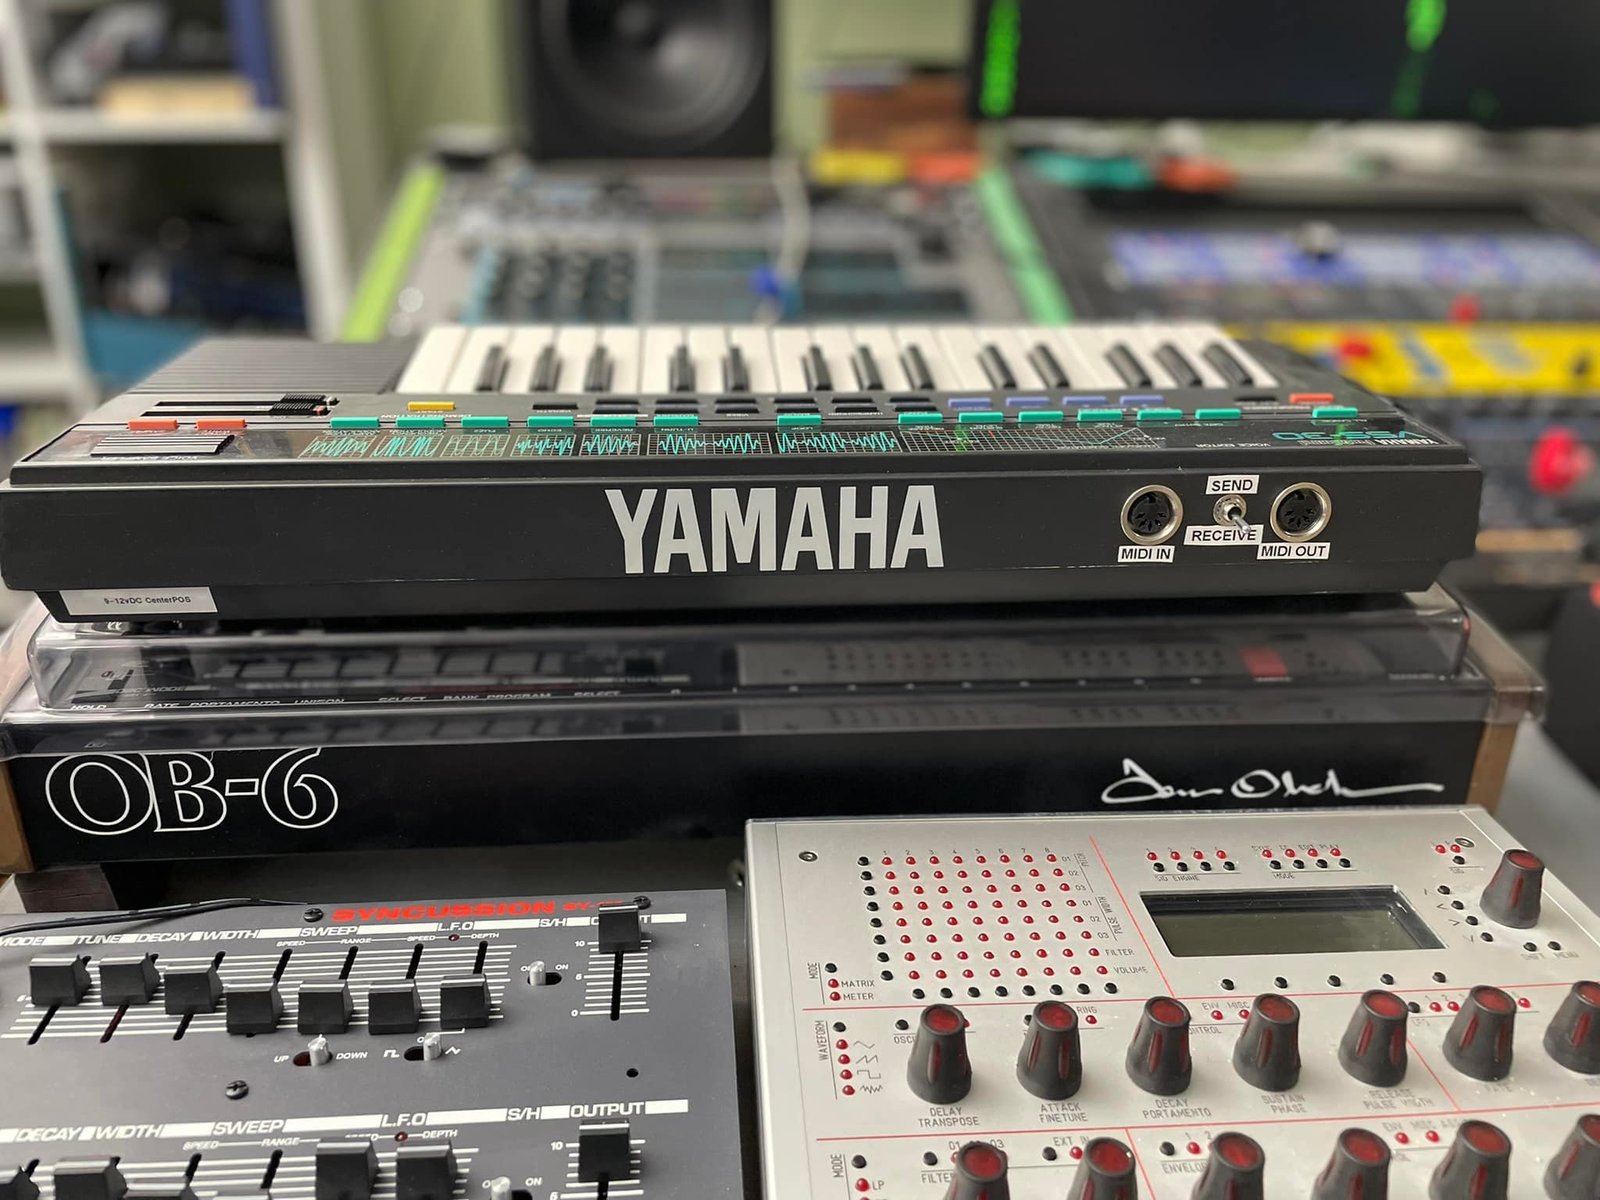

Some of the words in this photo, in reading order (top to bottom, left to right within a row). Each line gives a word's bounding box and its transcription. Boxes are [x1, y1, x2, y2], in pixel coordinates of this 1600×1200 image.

[1211, 479, 1254, 492] SEND
[604, 485, 944, 574] YAMAHA
[1191, 530, 1256, 542] RECEIVE
[1121, 549, 1154, 560] MIDI
[1156, 548, 1172, 559] IN
[1261, 546, 1294, 557] MIDI
[1295, 545, 1327, 557] OUT
[145, 596, 192, 604] CenterPOS
[45, 746, 339, 836] OB-6
[331, 900, 556, 922] SYNCUSSION
[76, 934, 122, 945] TUNE
[135, 932, 192, 943] DECAY
[201, 929, 260, 940] WIDTH
[300, 925, 358, 937] SWEEP
[539, 917, 567, 928] S/H
[340, 937, 372, 945] RANGE
[407, 934, 436, 942] SPEED
[471, 932, 500, 940] DEPTH
[555, 963, 569, 971] ON
[808, 962, 818, 979] MODE
[1113, 966, 1148, 974] VOLUME
[841, 980, 876, 988] MATRIX
[843, 992, 875, 1000] METER
[570, 1009, 579, 1017] 0
[1077, 1006, 1098, 1014] RING
[815, 1020, 829, 1061] WAVEFORM
[274, 1055, 290, 1063] UP
[336, 1052, 368, 1060] DOWN
[1040, 1102, 1082, 1113] ATTACK
[1155, 1098, 1189, 1109] DECAY
[1272, 1103, 1309, 1113] PHASE
[929, 1107, 963, 1117] DELAY
[1143, 1108, 1212, 1119] PORTAMENTO
[14, 1127, 82, 1142] DECAY
[92, 1124, 164, 1139] WIDTH
[212, 1119, 285, 1136] SWEEP
[506, 1106, 542, 1121] S/H
[570, 1101, 645, 1118] OUTPUT
[918, 1116, 981, 1128] TRANSPOSE
[1039, 1112, 1089, 1124] FINETUNE
[182, 1140, 219, 1151] SPEED
[261, 1138, 300, 1147] RANGE
[422, 1129, 458, 1139] DEPTH
[1204, 1130, 1212, 1140] 2
[551, 1141, 563, 1150] 10
[948, 1140, 960, 1151] 01
[1052, 1136, 1073, 1147] EXT
[831, 1153, 844, 1178] MODE
[525, 1177, 543, 1187] ON
[921, 1172, 956, 1184] FILTE
[872, 1180, 885, 1191] LP
